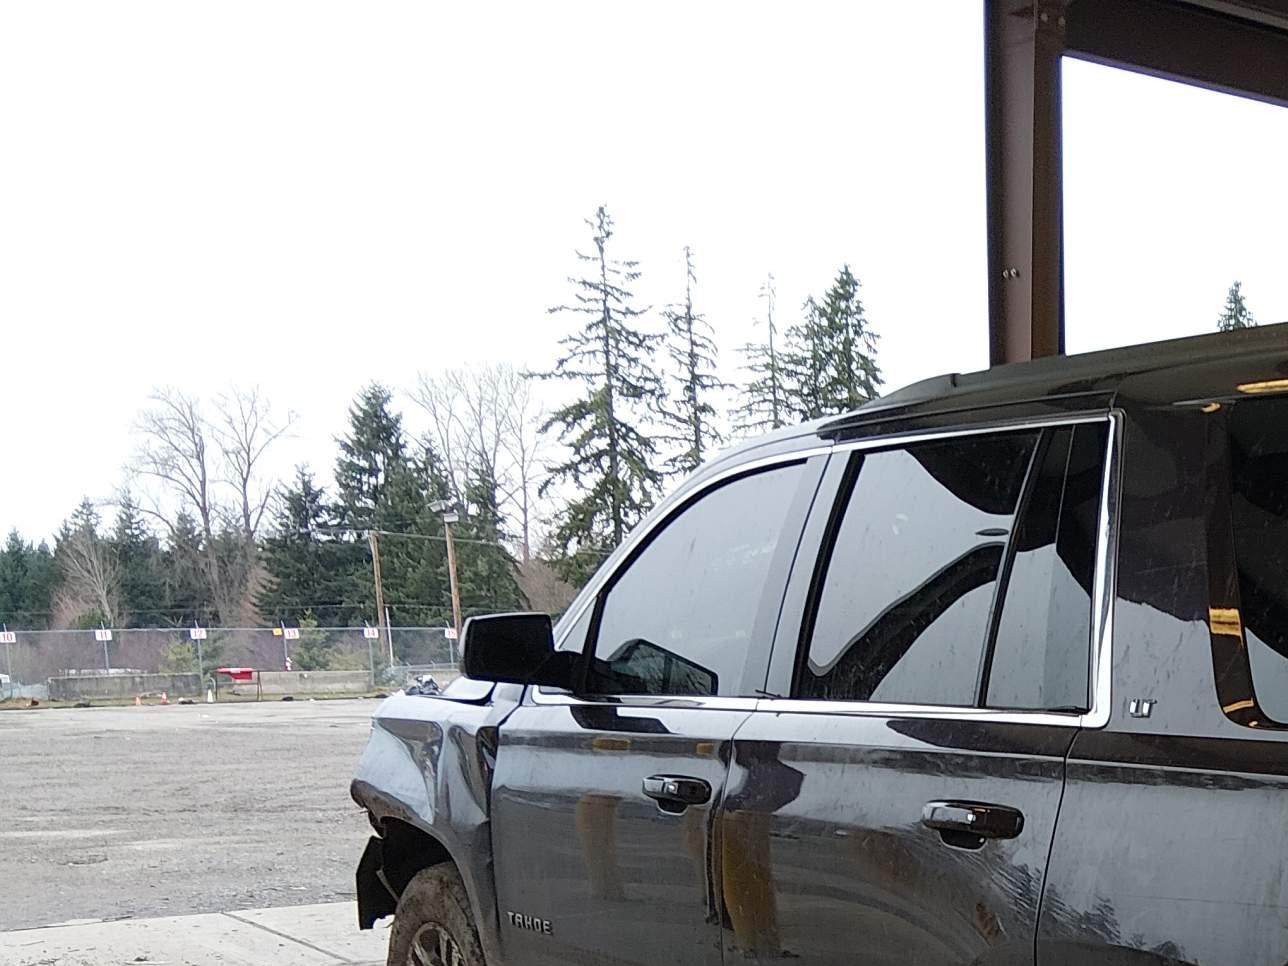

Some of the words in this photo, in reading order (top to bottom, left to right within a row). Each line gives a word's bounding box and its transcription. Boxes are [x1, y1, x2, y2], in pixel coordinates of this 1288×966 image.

[2, 632, 13, 641] 10
[100, 631, 108, 640] 11
[1129, 699, 1157, 718] LT
[507, 911, 552, 935] TAHOE
